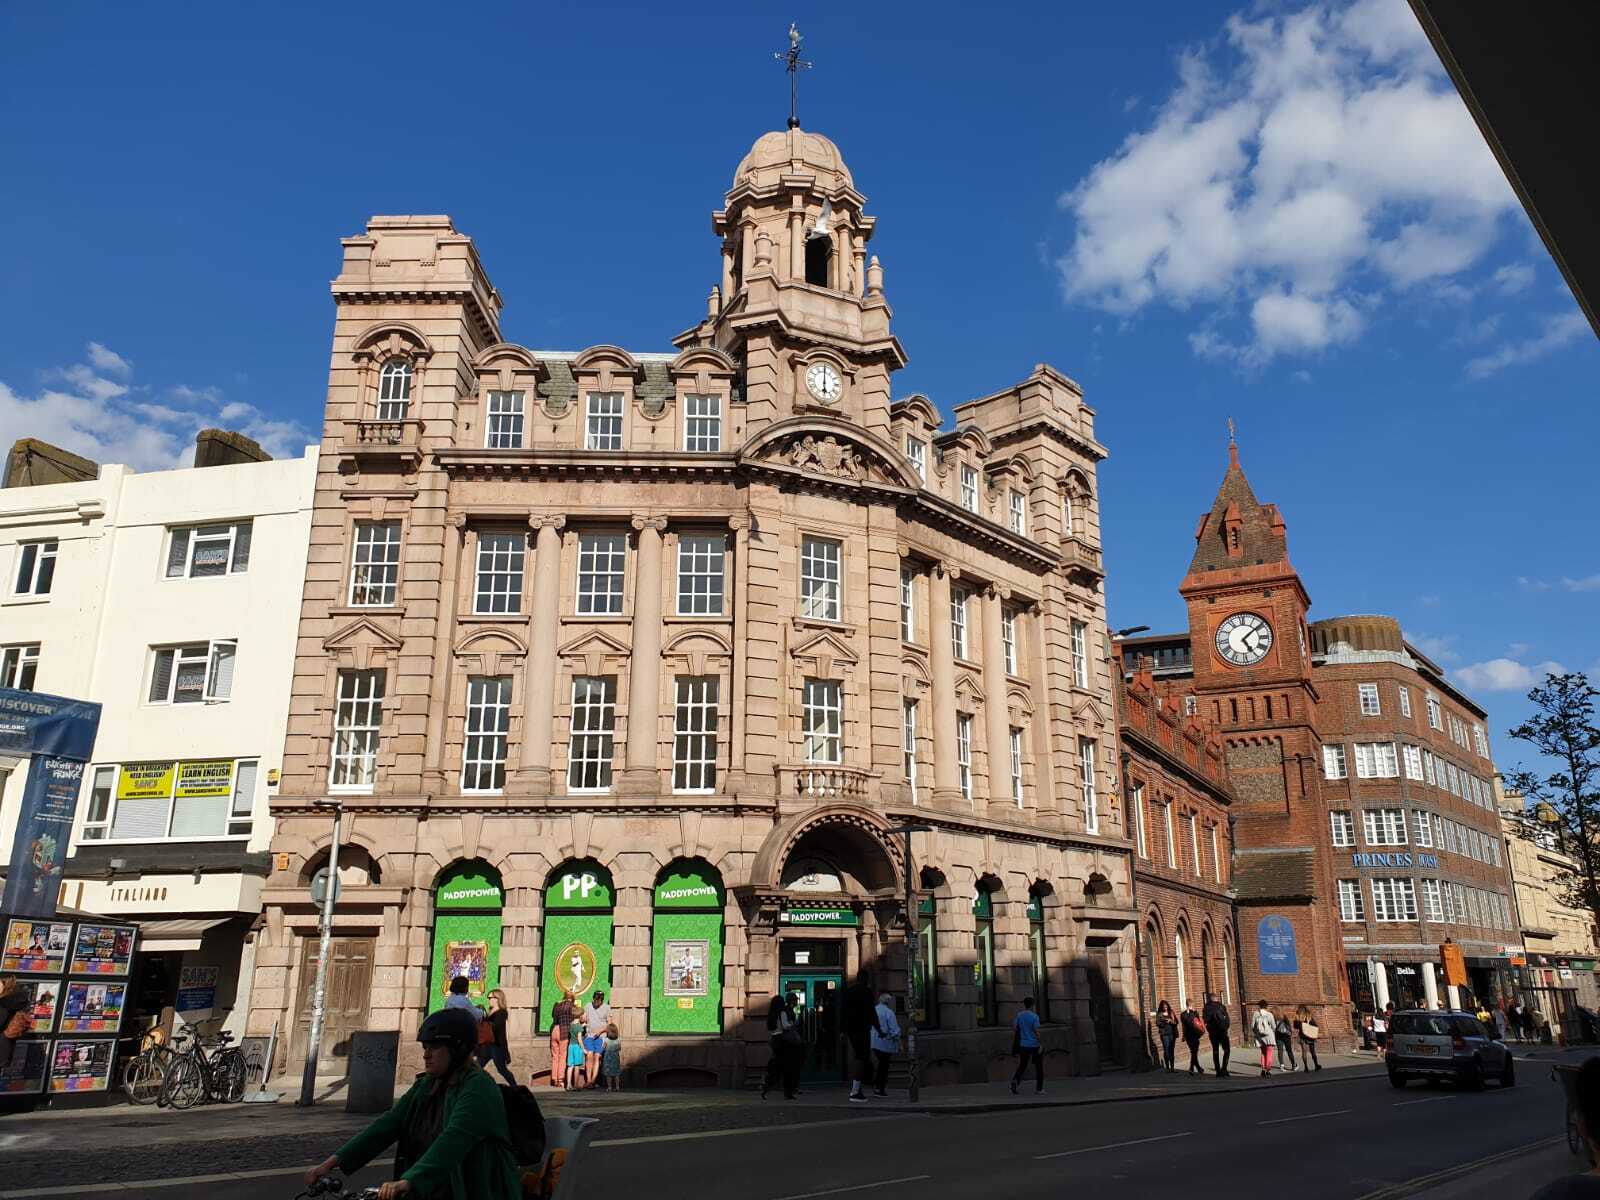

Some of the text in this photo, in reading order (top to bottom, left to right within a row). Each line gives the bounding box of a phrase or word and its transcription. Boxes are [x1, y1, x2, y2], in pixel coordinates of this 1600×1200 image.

[182, 768, 230, 778] LEARN ENGLISH
[1352, 852, 1412, 867] PRINCES
[111, 888, 167, 901] ITALIANO
[1396, 967, 1415, 975] Bella
